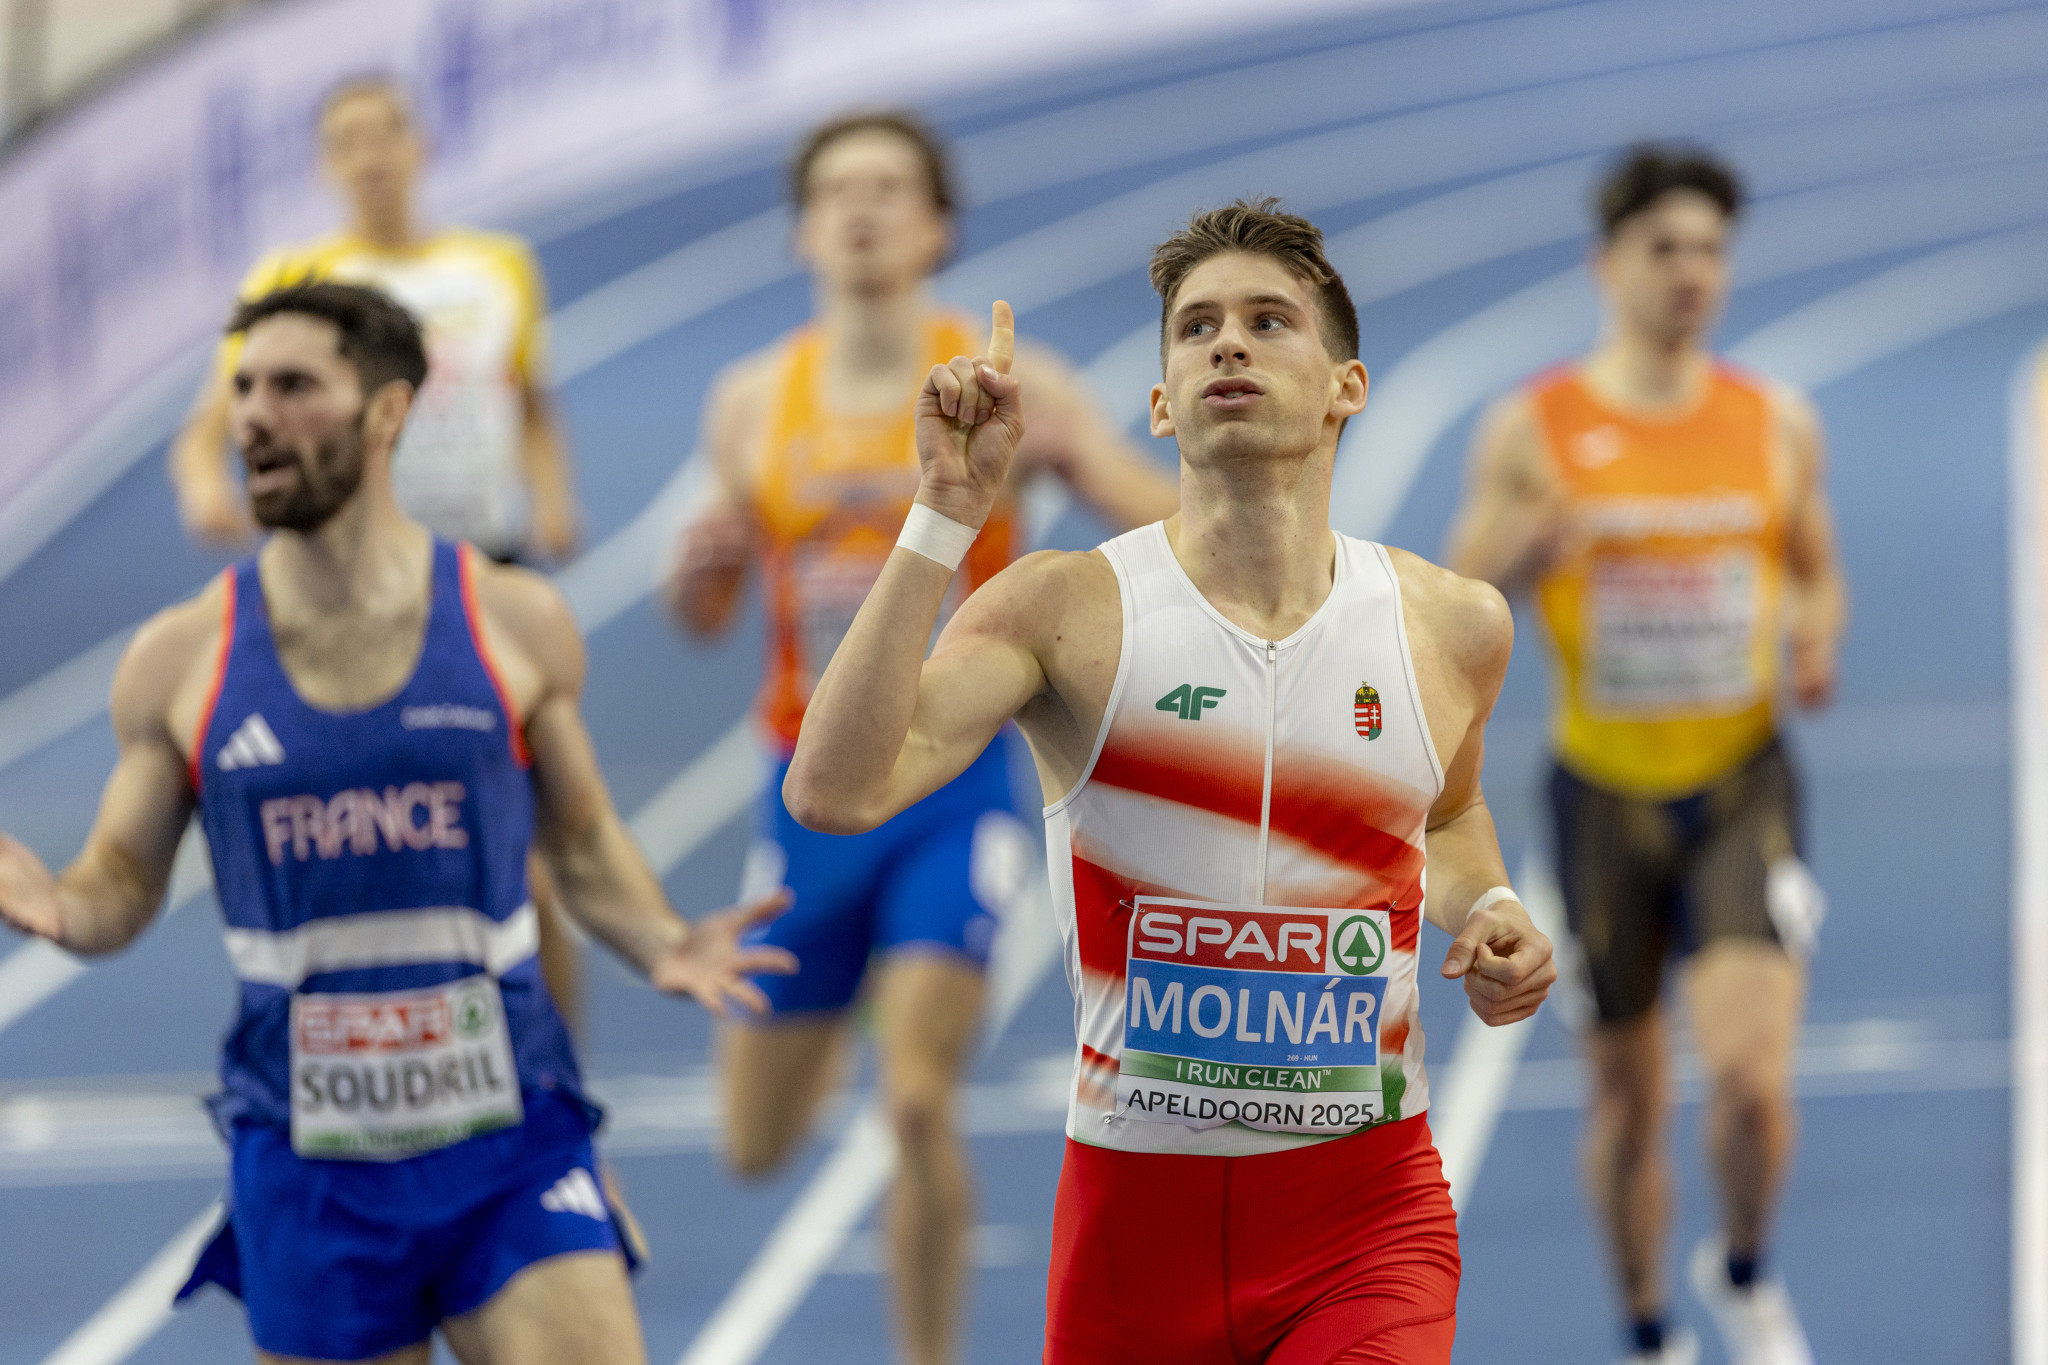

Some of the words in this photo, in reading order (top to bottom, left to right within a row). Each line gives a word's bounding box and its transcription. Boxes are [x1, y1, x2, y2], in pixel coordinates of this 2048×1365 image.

[1155, 683, 1227, 721] 4F
[261, 781, 470, 866] FRANCE
[1138, 912, 1323, 964] SPAR
[1130, 976, 1376, 1045] MOLNÁR
[301, 1051, 502, 1113] SOUDRIL
[1176, 1061, 1182, 1080] I
[1187, 1063, 1239, 1085] RUN
[1128, 1089, 1304, 1126] APELDOORN
[1310, 1103, 1375, 1126] 2025
